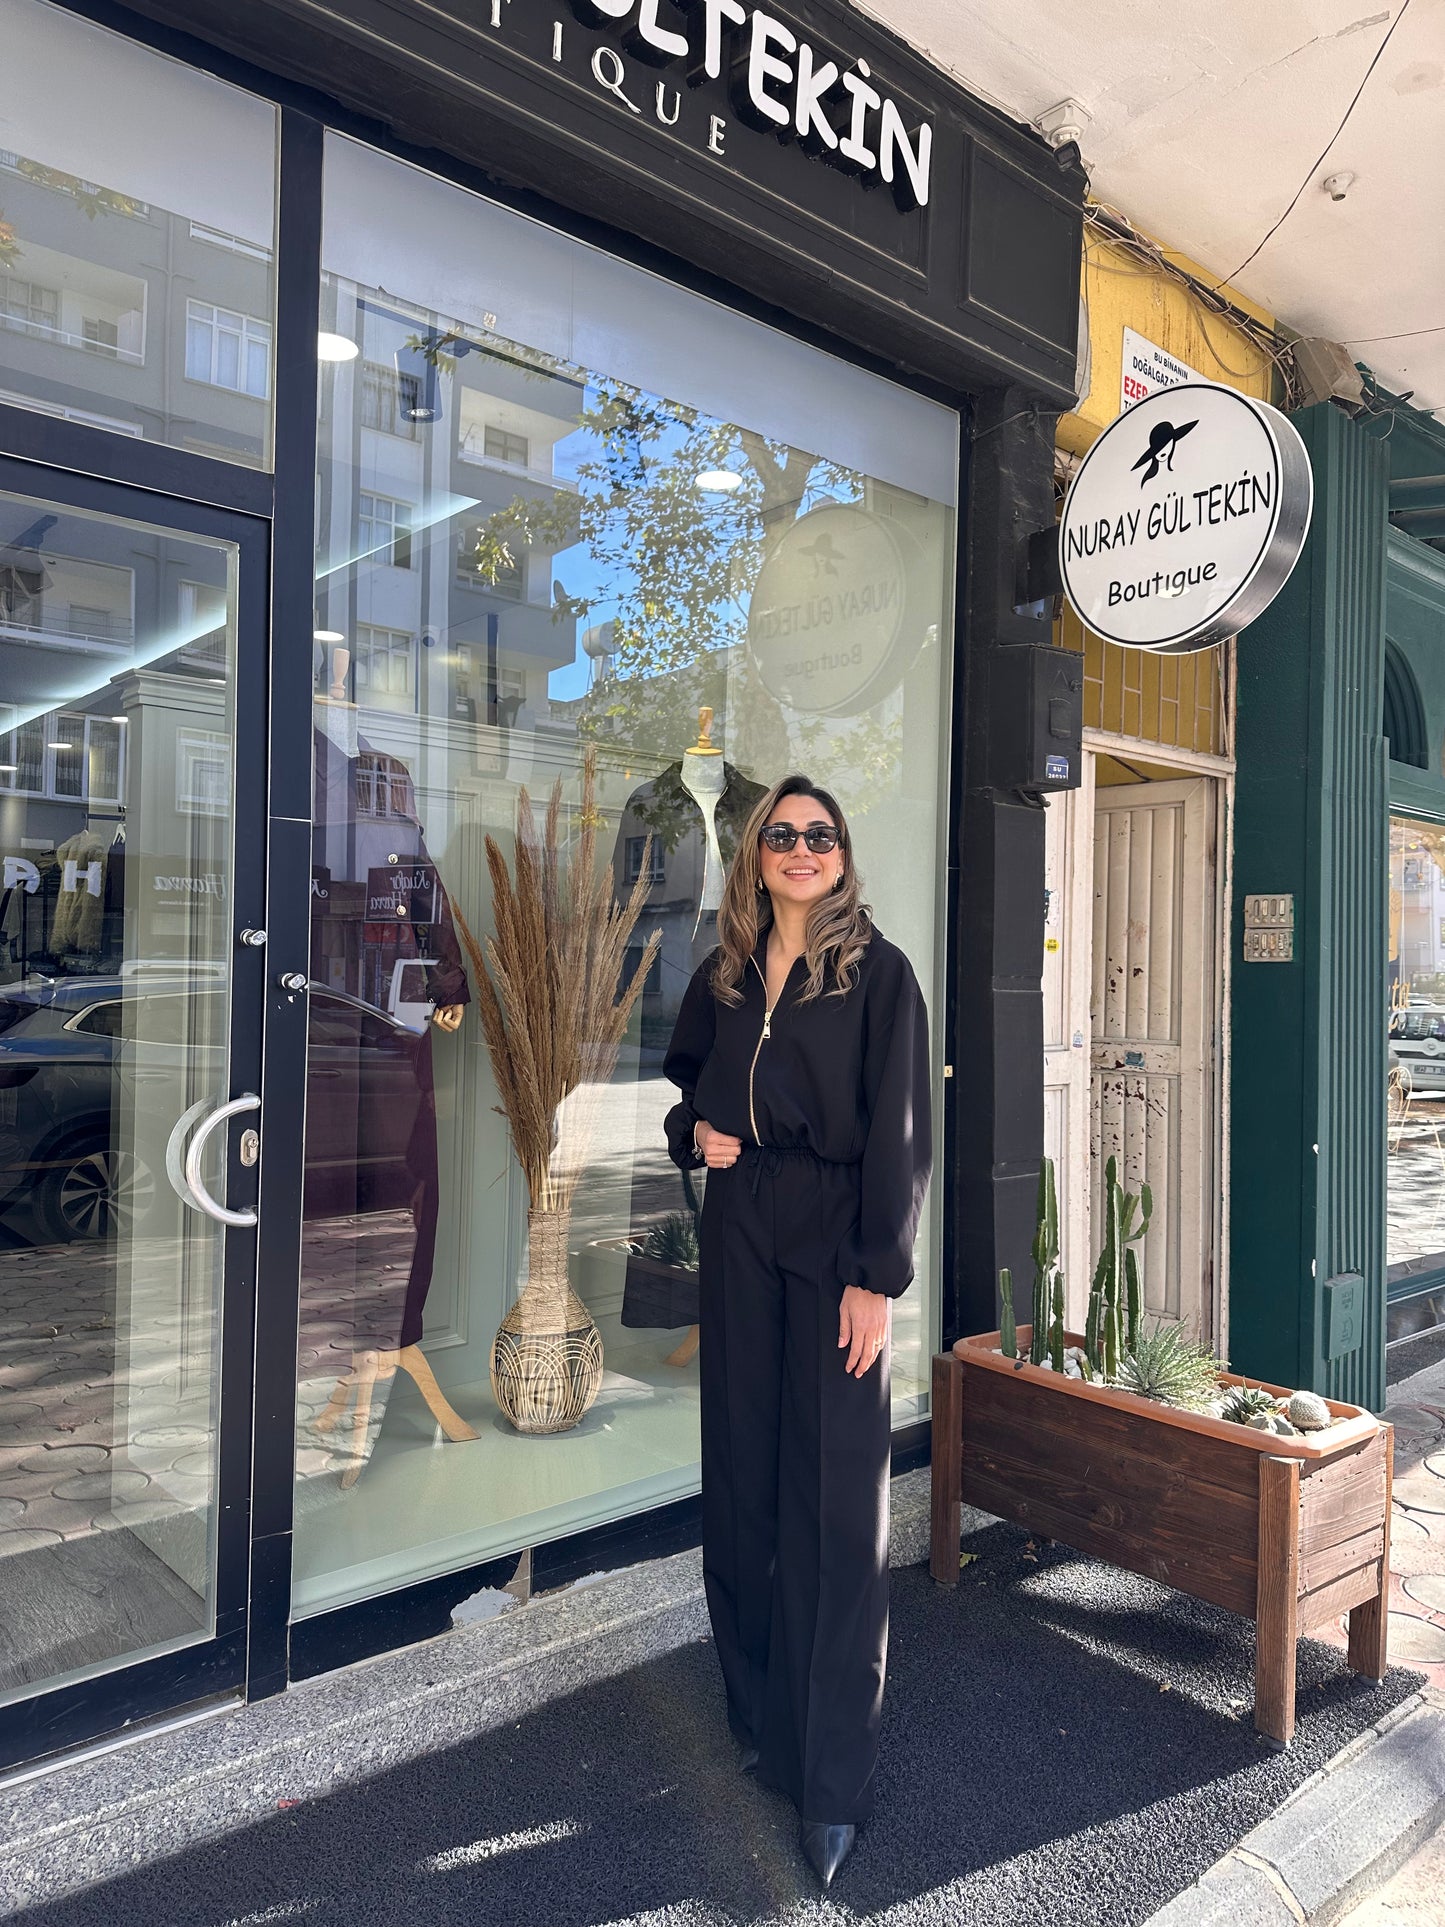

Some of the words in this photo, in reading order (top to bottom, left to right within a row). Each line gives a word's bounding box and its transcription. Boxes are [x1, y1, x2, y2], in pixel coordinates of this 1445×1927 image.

[590, 0, 932, 206] LTEKİN
[1132, 356, 1169, 387] DOĞALGAZ
[1153, 352, 1163, 364] BU
[1163, 358, 1189, 380] BİNANIN
[1068, 508, 1141, 562] NURAY
[1147, 470, 1271, 541] GÜLTEKİN
